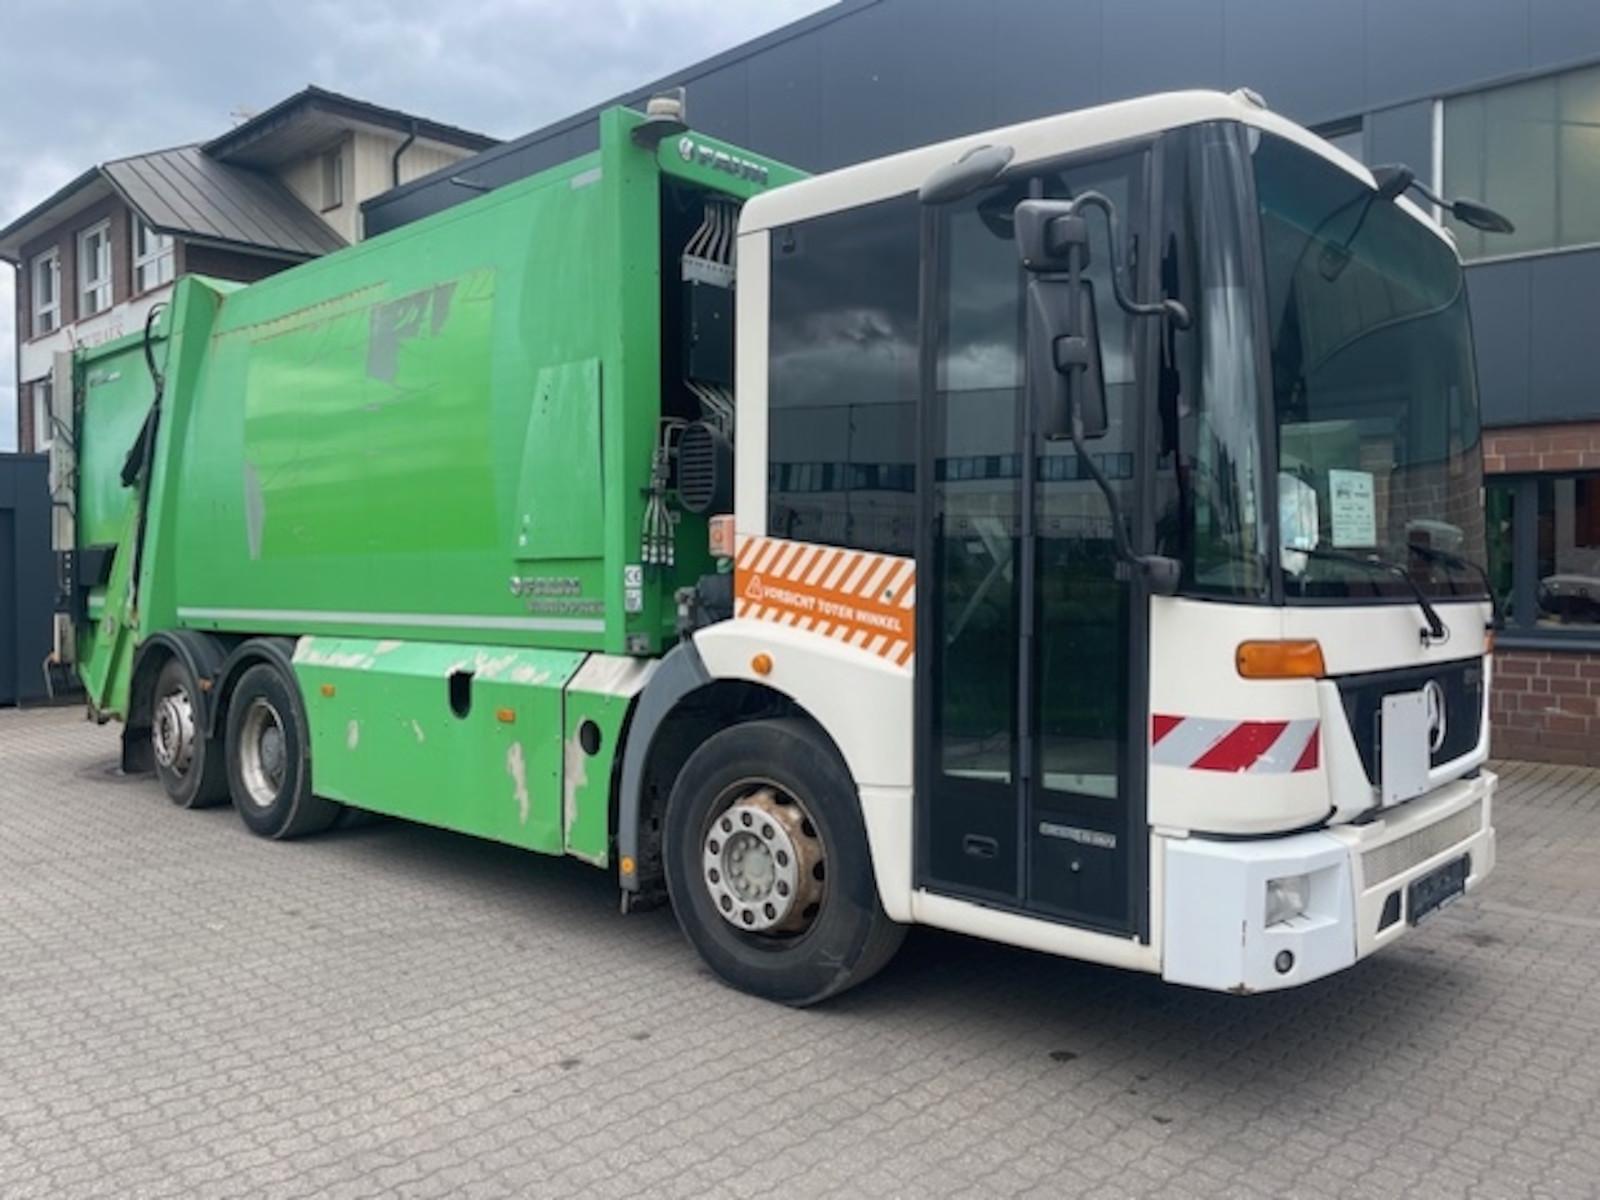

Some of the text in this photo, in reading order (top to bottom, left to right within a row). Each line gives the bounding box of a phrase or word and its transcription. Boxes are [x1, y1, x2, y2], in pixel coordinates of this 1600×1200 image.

[764, 587, 902, 631] VORSICHT TOTER WINKEL
